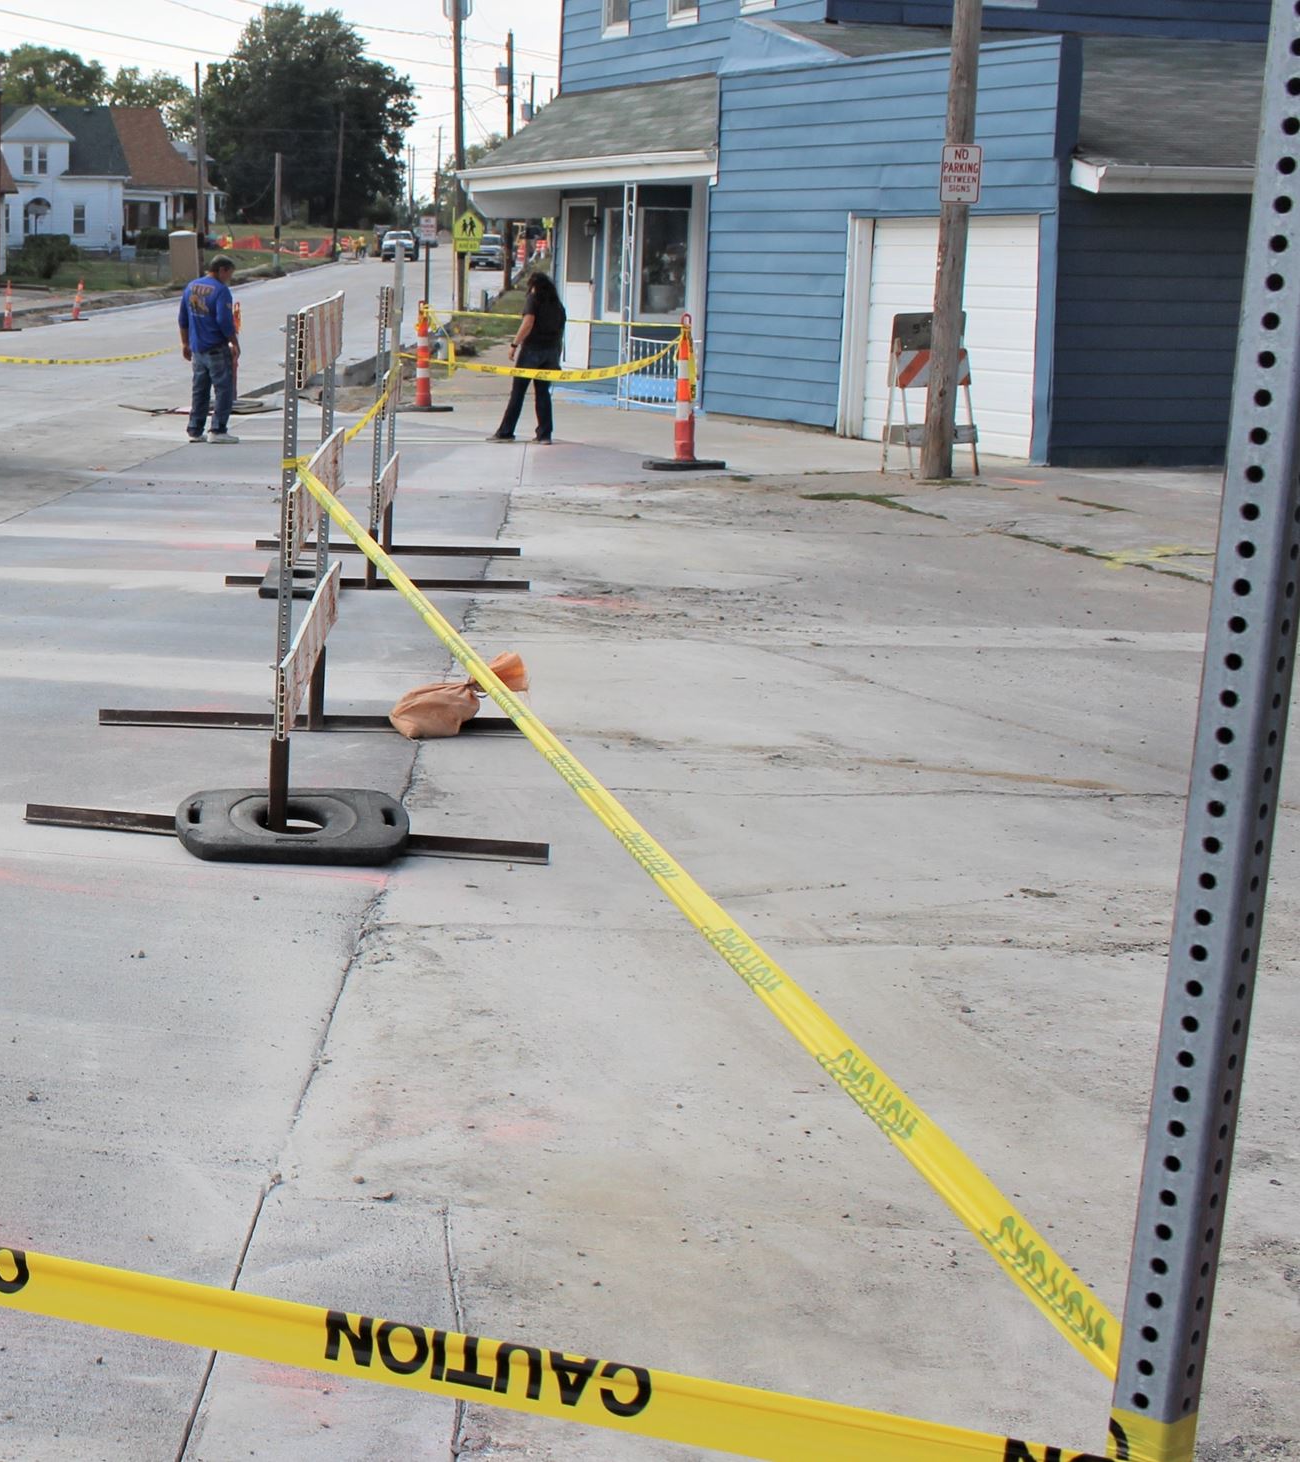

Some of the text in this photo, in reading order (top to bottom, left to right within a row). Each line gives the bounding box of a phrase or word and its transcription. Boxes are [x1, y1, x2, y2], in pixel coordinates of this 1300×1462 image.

[954, 148, 969, 160] NO
[943, 162, 979, 173] PARKING
[943, 175, 976, 183] BETWEEN
[948, 184, 971, 192] SIGNS
[324, 1310, 651, 1417] CAUTION
